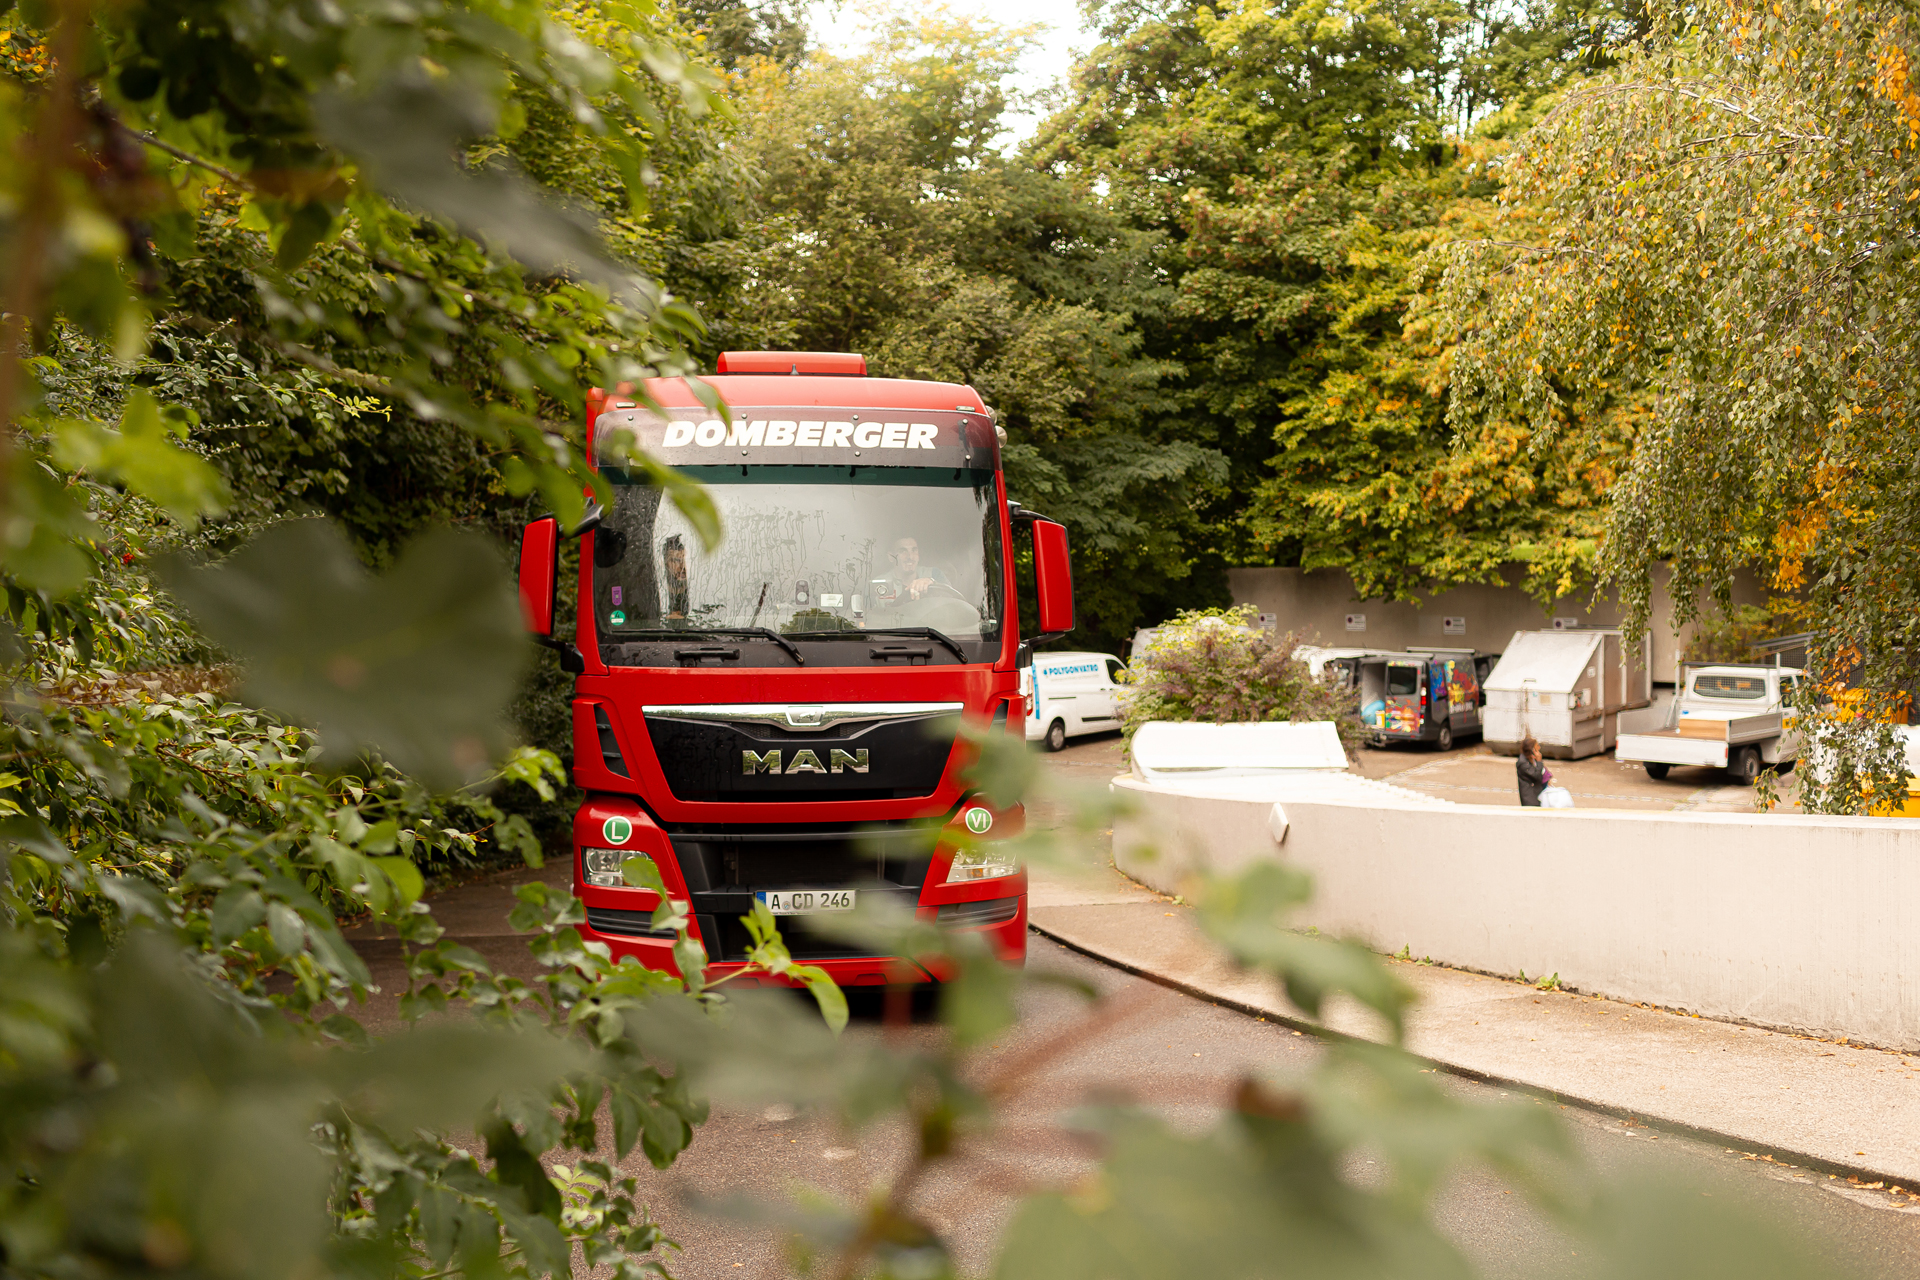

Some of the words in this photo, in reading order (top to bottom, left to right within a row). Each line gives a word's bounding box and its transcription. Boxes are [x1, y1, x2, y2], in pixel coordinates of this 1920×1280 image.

[662, 421, 938, 449] DOMBERGER
[742, 748, 869, 775] MAN
[971, 812, 987, 828] VI
[612, 821, 623, 840] L
[771, 894, 781, 910] A
[792, 893, 814, 909] CD
[820, 892, 850, 908] 246
